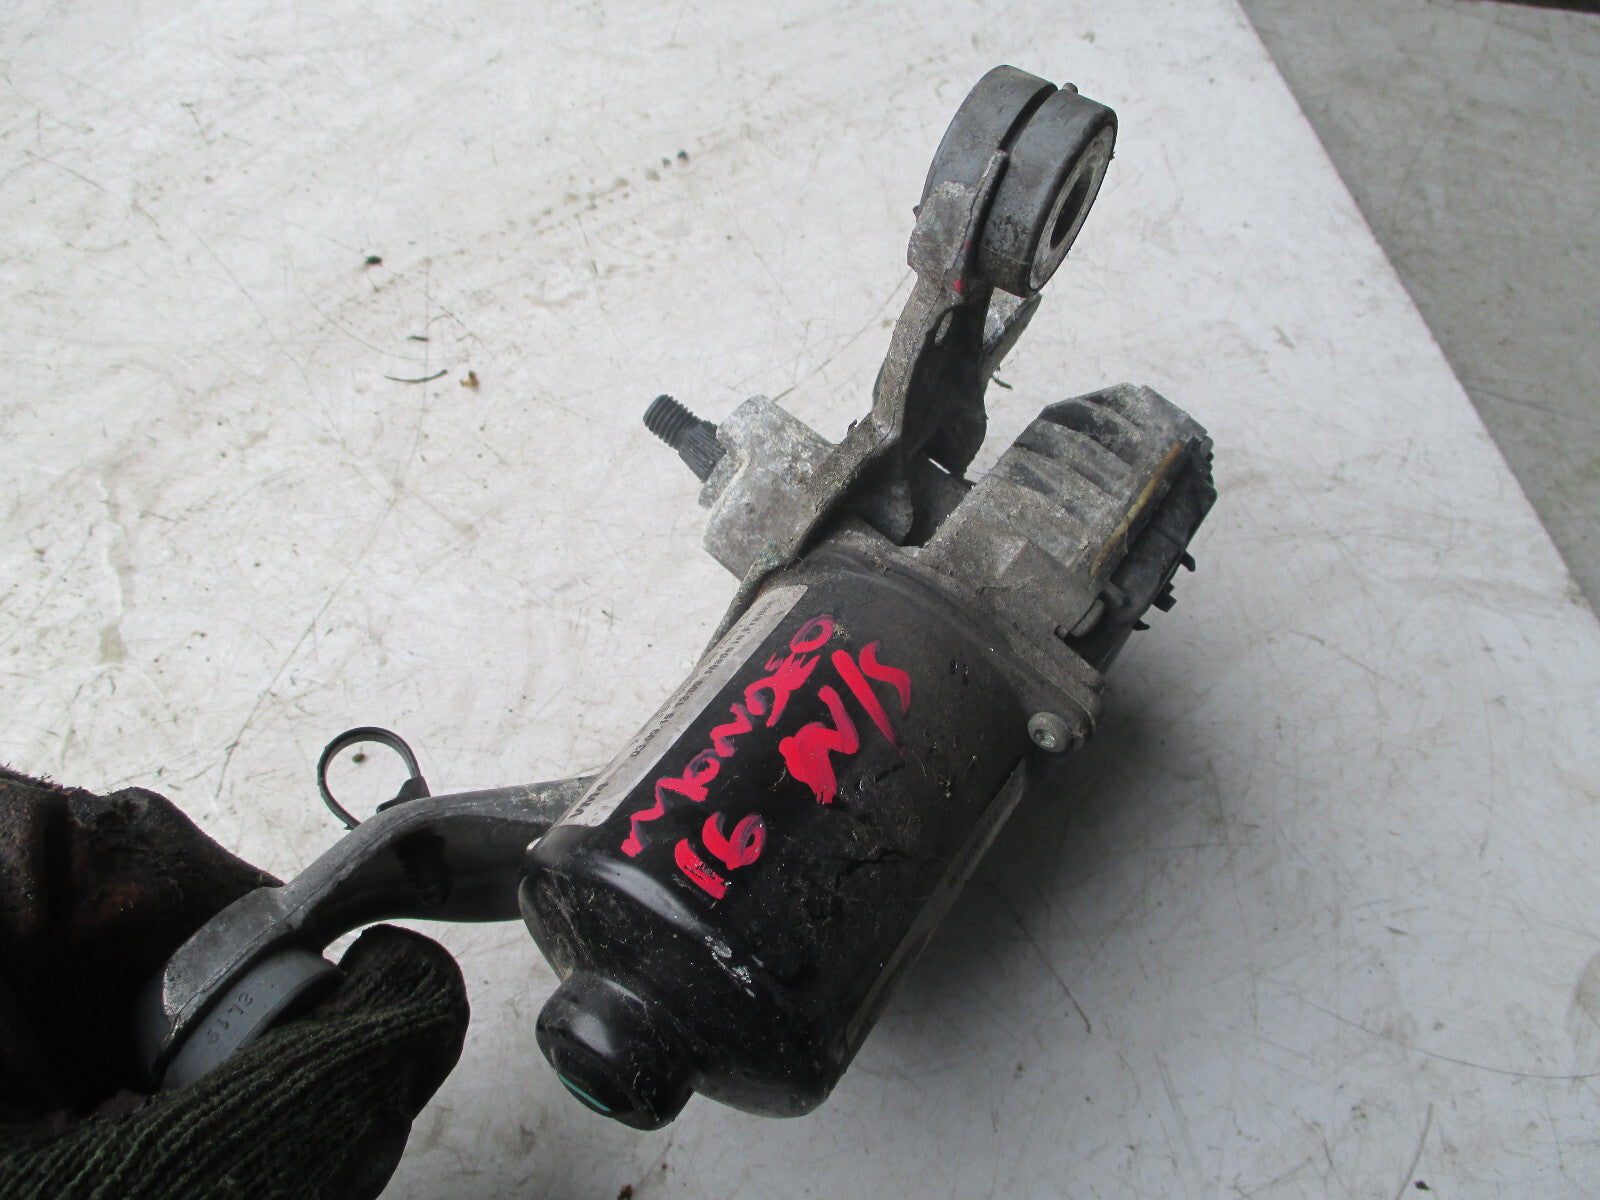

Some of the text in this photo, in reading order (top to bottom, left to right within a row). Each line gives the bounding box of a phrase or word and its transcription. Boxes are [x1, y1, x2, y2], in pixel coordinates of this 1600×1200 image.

[703, 646, 734, 675] Made
[620, 613, 837, 857] MONDEO
[674, 811, 767, 899] 16
